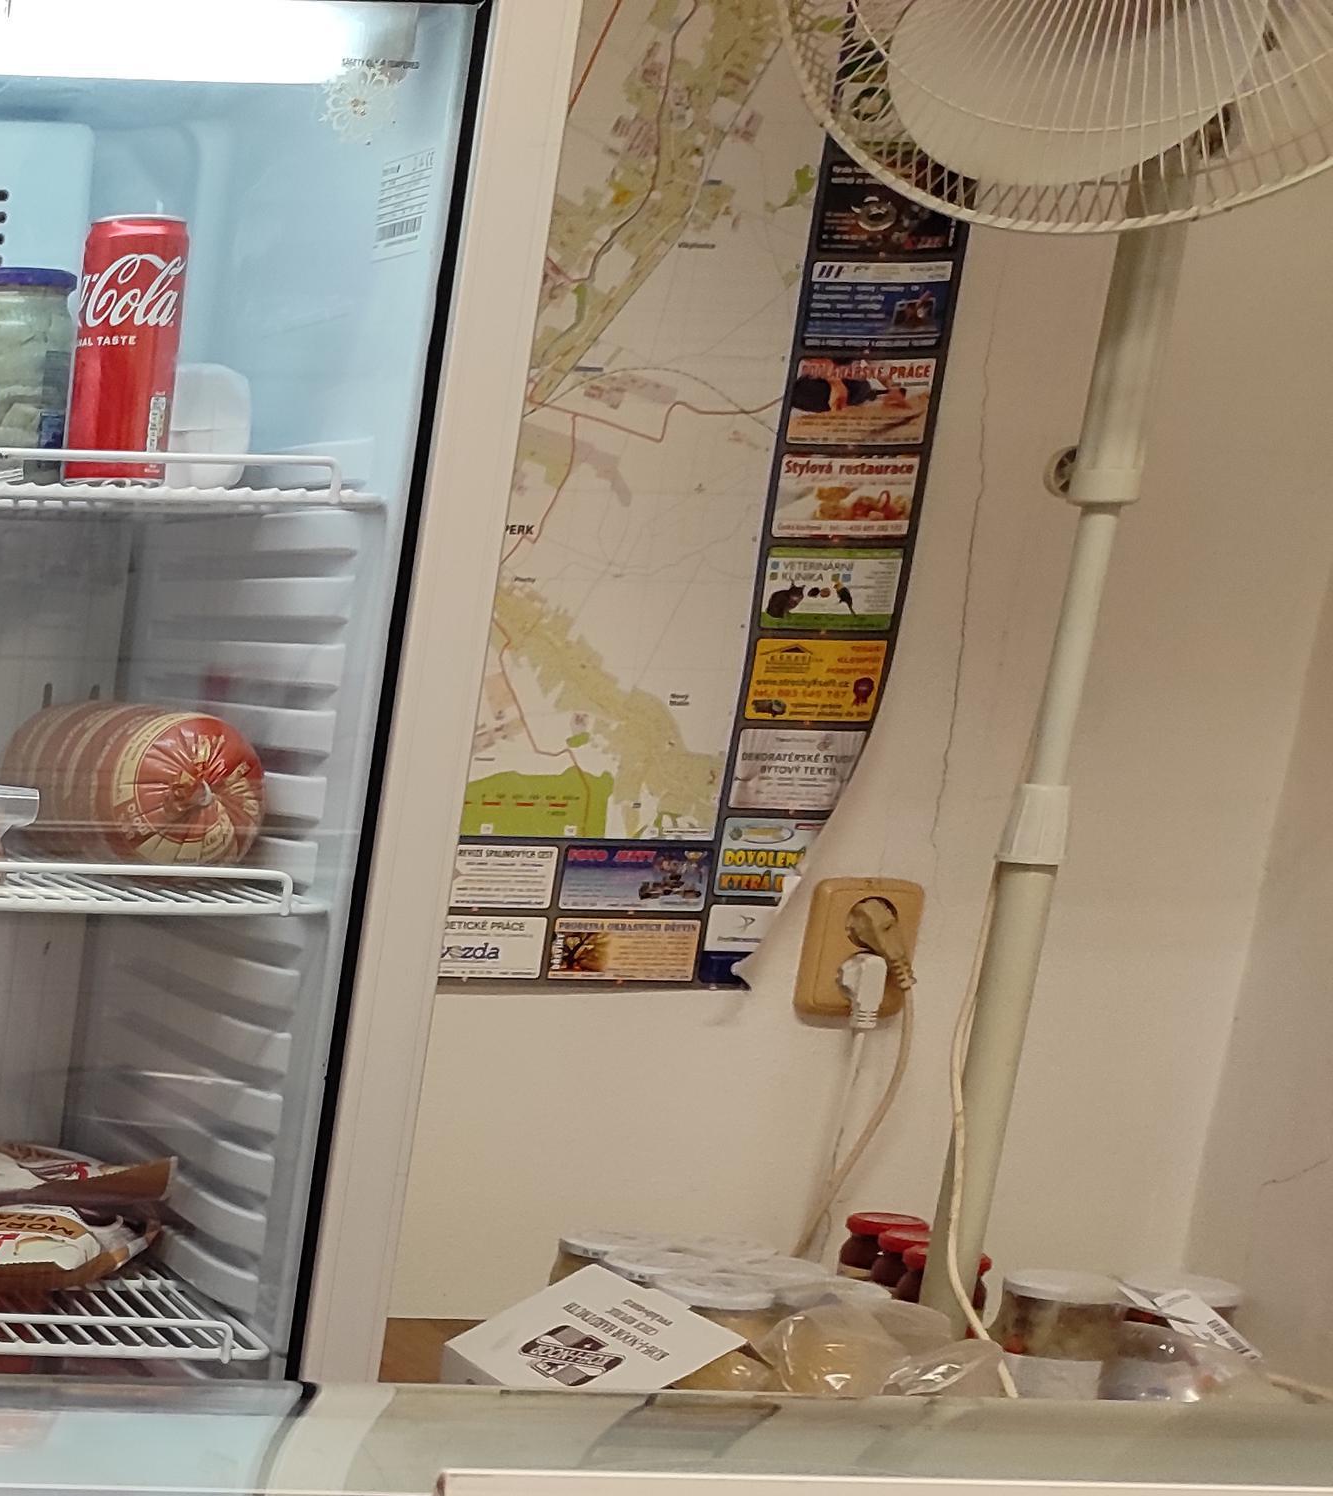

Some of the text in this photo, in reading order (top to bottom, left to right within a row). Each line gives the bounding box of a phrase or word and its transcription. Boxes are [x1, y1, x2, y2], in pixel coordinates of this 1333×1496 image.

[97, 335, 137, 347] TASTE
[889, 363, 932, 379] PRÁCE
[784, 459, 915, 477] Stylová restaurace
[781, 571, 824, 582] KLINIKA
[760, 764, 837, 776] BYTOVÝ TEXTIL
[490, 920, 526, 931] PRÁCE
